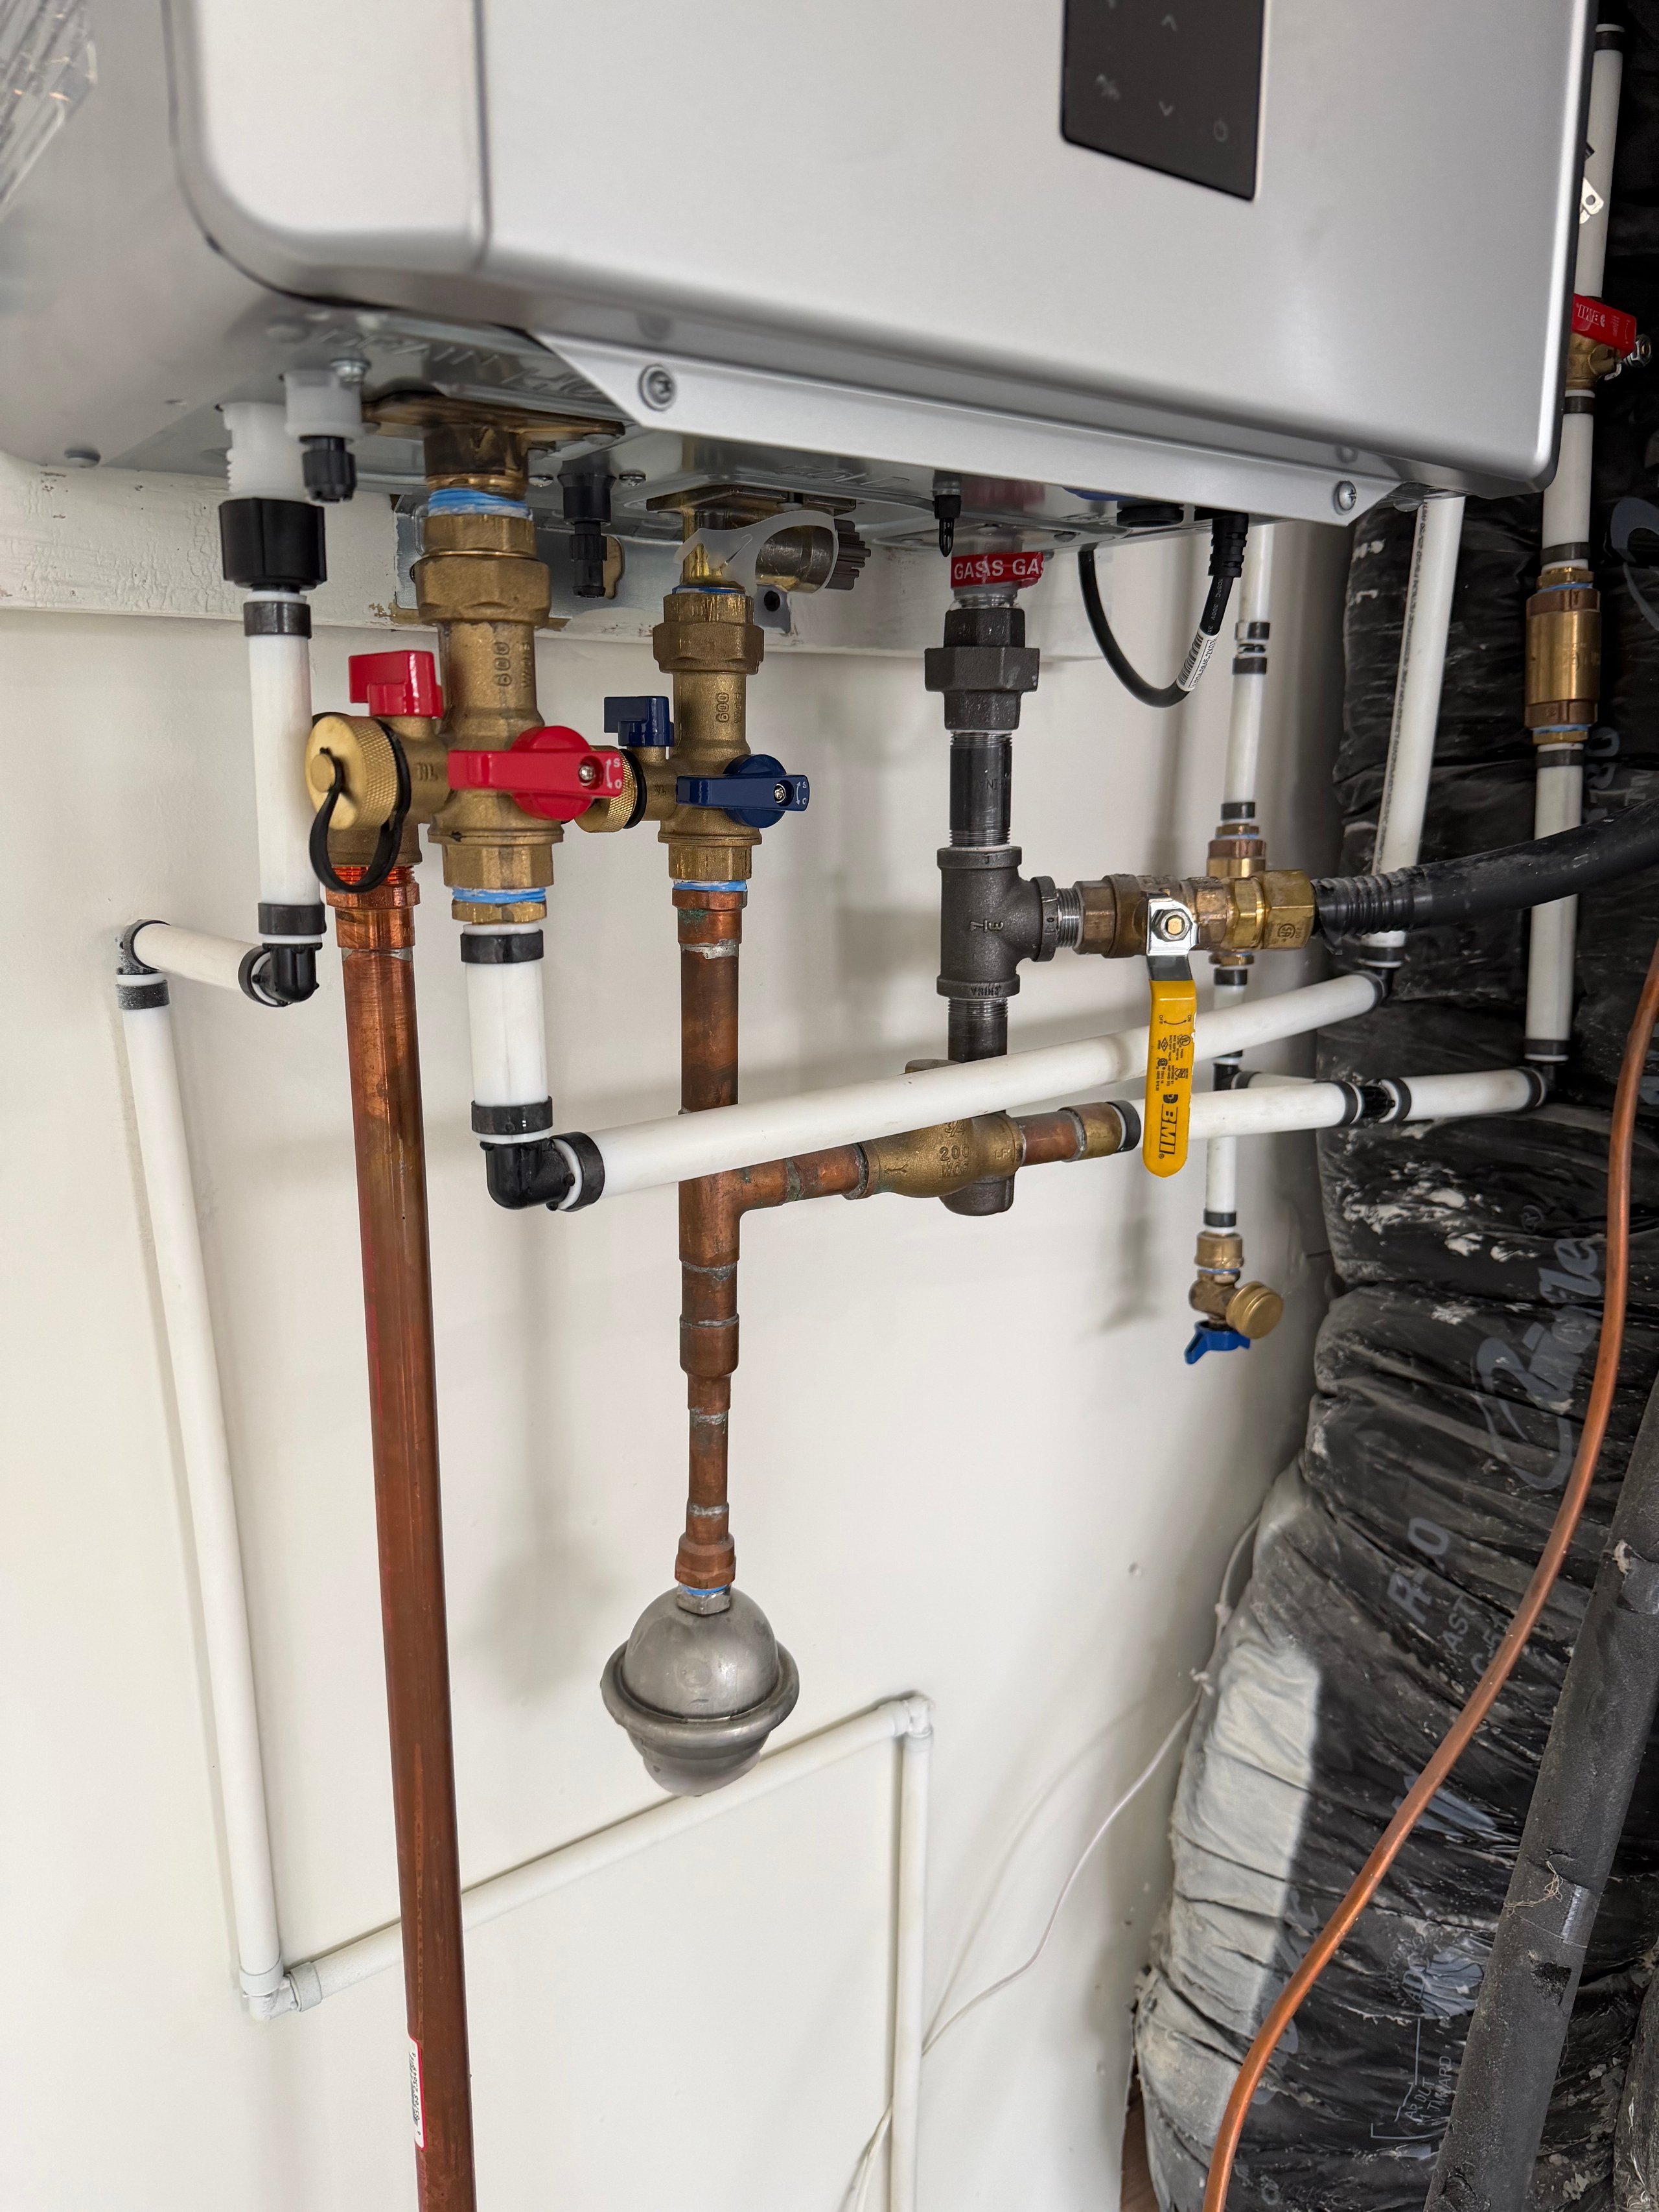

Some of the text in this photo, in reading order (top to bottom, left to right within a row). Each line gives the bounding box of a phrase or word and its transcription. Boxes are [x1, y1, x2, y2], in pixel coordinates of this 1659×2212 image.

[1012, 558, 1043, 576] GA
[494, 642, 511, 686] 600
[715, 692, 730, 723] 600
[802, 780, 807, 789] S
[1159, 1104, 1178, 1154] BMI
[940, 1143, 969, 1161] 200
